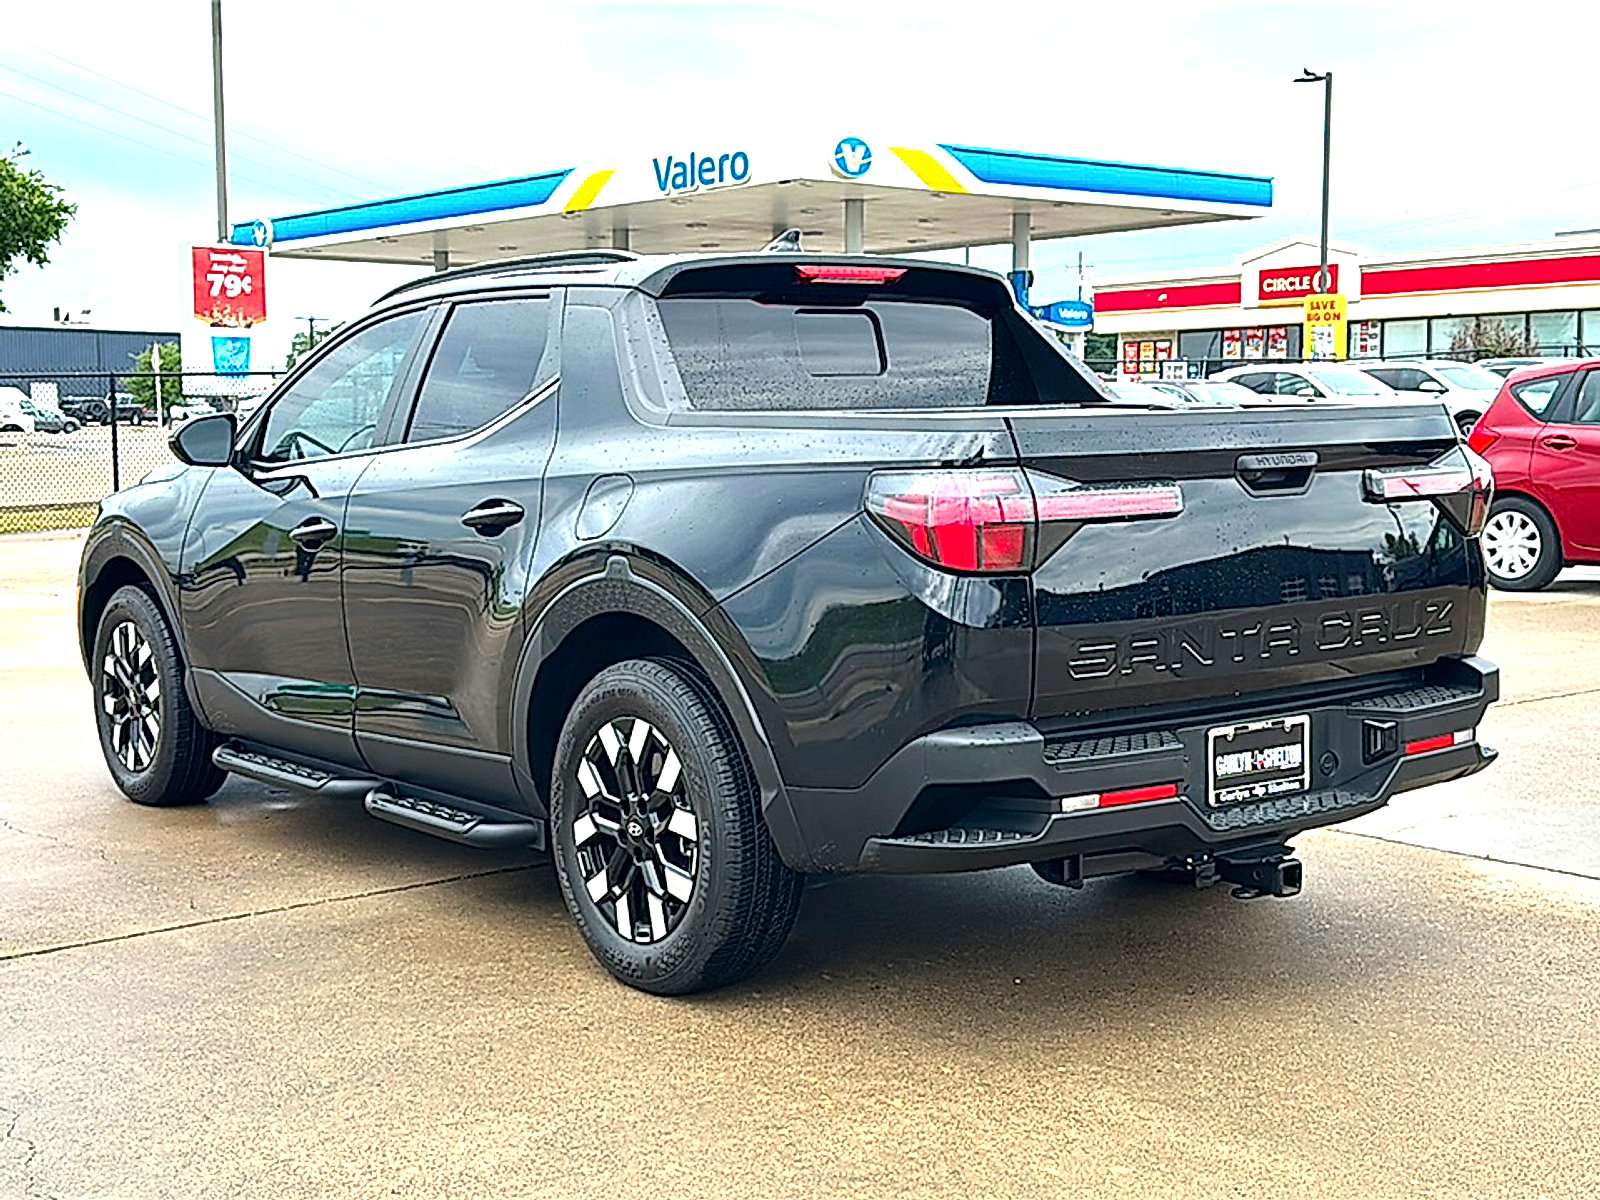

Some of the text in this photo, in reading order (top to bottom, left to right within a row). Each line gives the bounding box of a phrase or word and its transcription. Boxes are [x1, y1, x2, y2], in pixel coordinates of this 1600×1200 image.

[652, 151, 750, 192] Valero
[1262, 275, 1311, 293] CIRCLE
[1310, 300, 1336, 311] SAVE
[1058, 307, 1088, 320] Valero
[1323, 312, 1341, 321] ON
[1255, 454, 1309, 466] HYUNDAI
[1066, 600, 1455, 680] SANTA CRUZ
[699, 820, 713, 914] KUMHO
